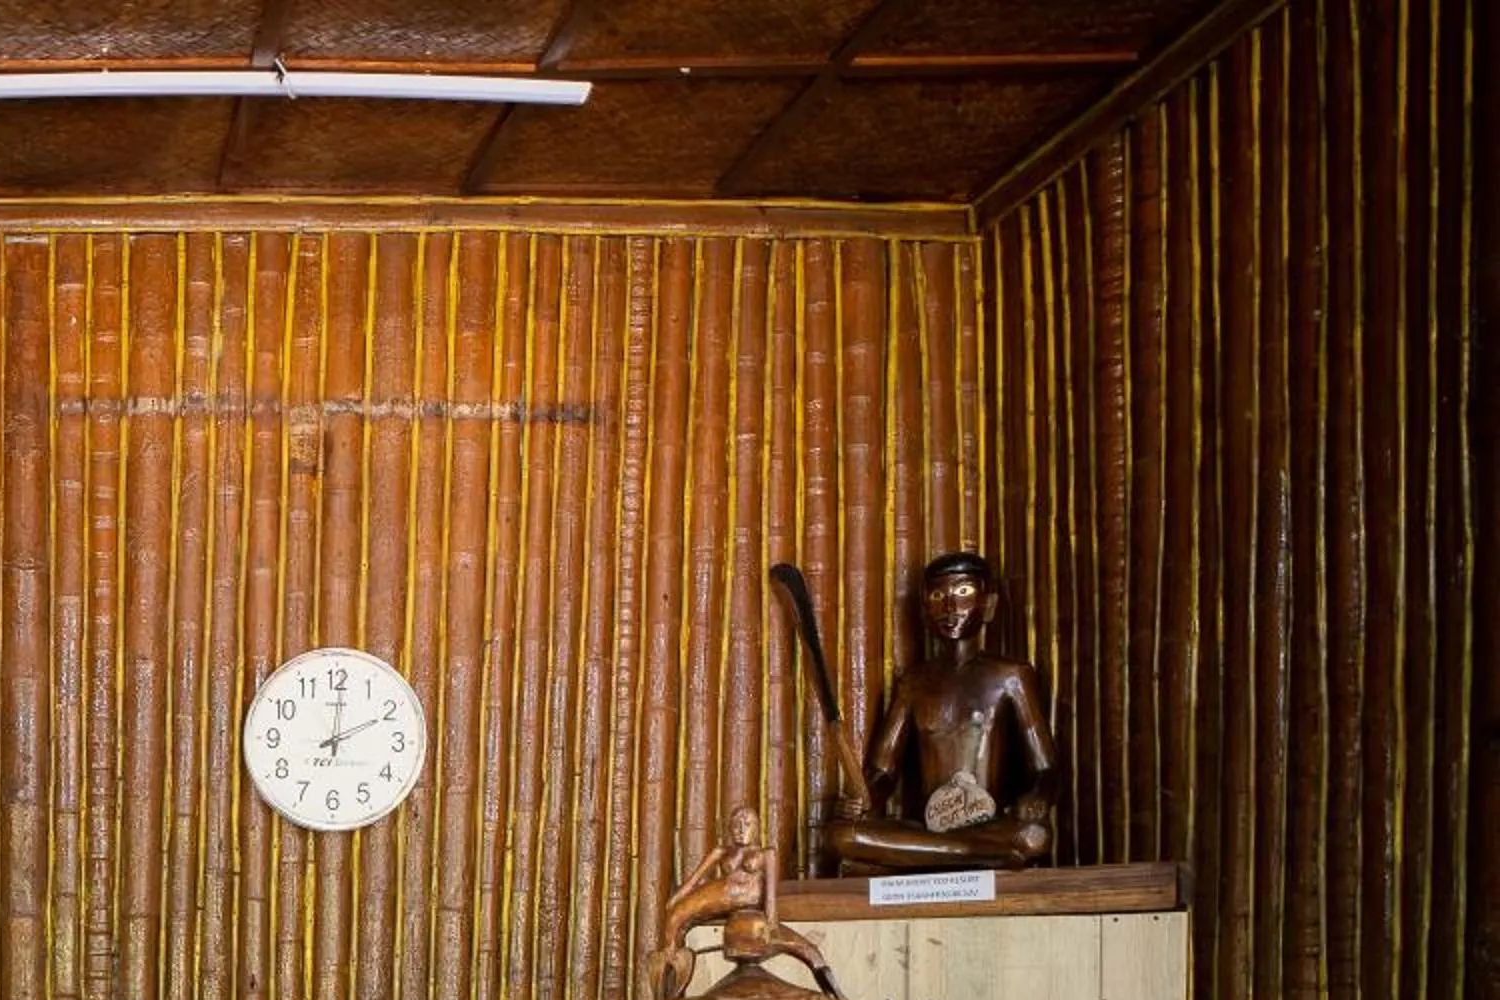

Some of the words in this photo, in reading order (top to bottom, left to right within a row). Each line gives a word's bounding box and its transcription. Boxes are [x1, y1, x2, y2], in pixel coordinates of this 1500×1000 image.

[298, 677, 317, 699] 11
[327, 668, 349, 691] 12
[364, 678, 372, 700] 1
[275, 699, 297, 721] 10
[382, 699, 397, 721] 2
[266, 727, 281, 749] 9
[391, 731, 405, 753] 3
[275, 758, 289, 779] 8
[379, 761, 393, 783] 4
[296, 781, 311, 802] 7
[325, 789, 340, 811] 6
[356, 782, 370, 804] 5
